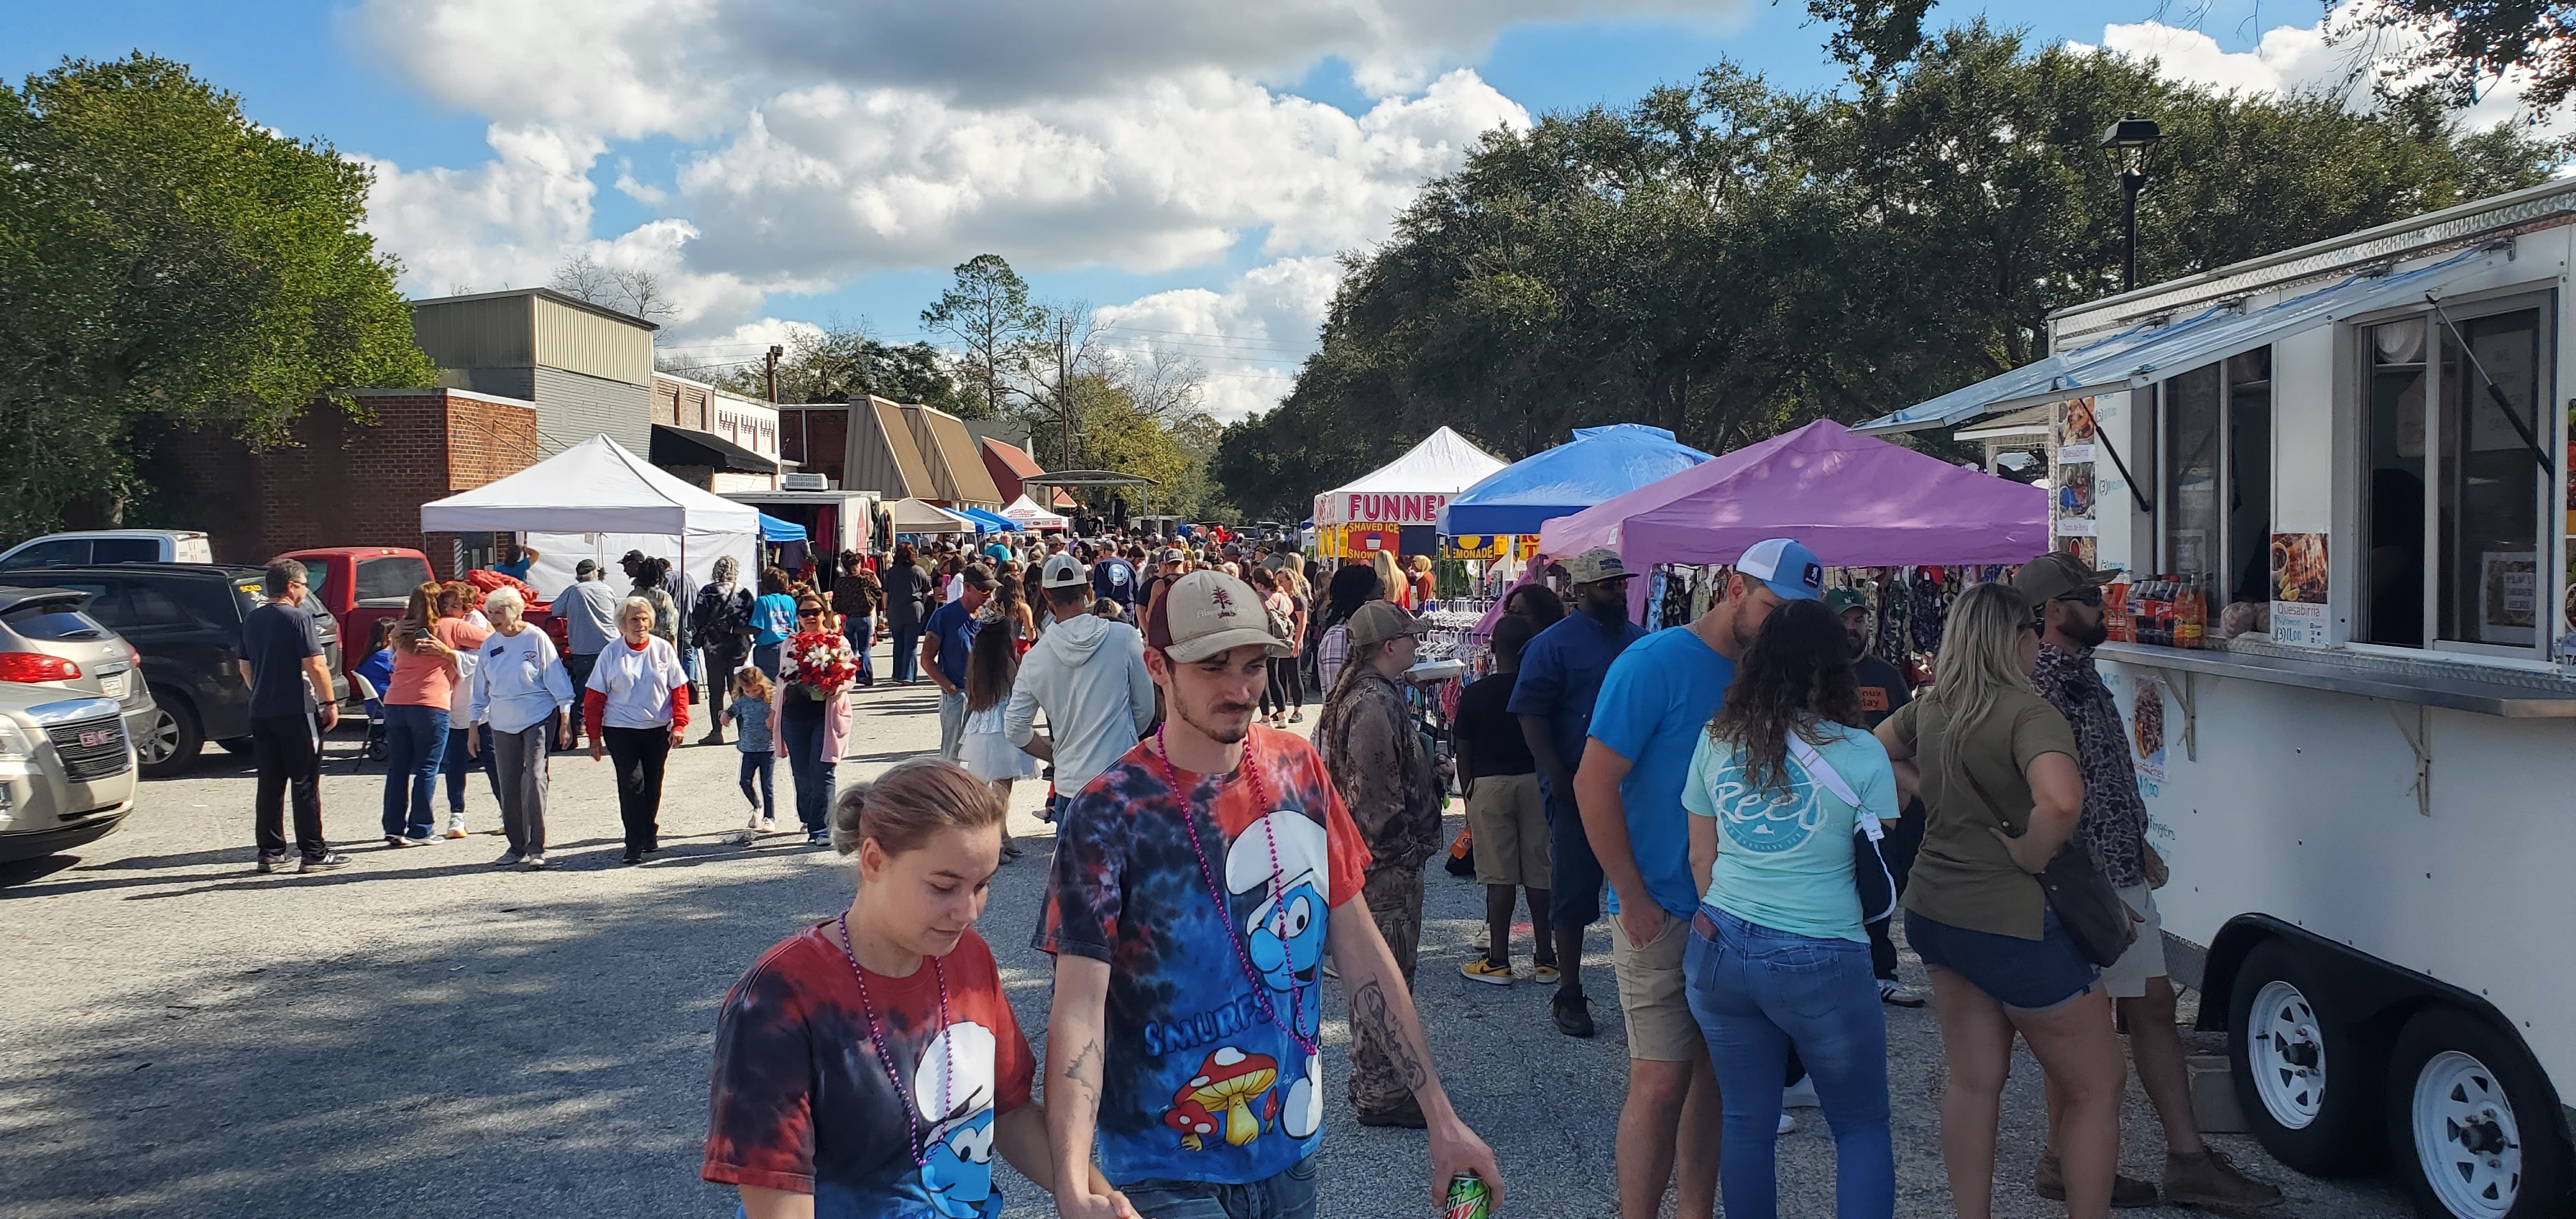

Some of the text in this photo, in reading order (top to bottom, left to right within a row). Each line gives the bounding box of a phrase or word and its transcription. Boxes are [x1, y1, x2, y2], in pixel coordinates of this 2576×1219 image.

[1349, 523, 1399, 534] SHAVED ICE
[1348, 549, 1398, 560] SNOWL
[1445, 544, 1493, 559] LEMONADE
[239, 584, 262, 593] SCAD
[2278, 603, 2320, 617] Quesabirria
[79, 730, 118, 747] GMC
[2149, 813, 2175, 841] Fingers
[1144, 987, 1274, 1056] SMURFS
